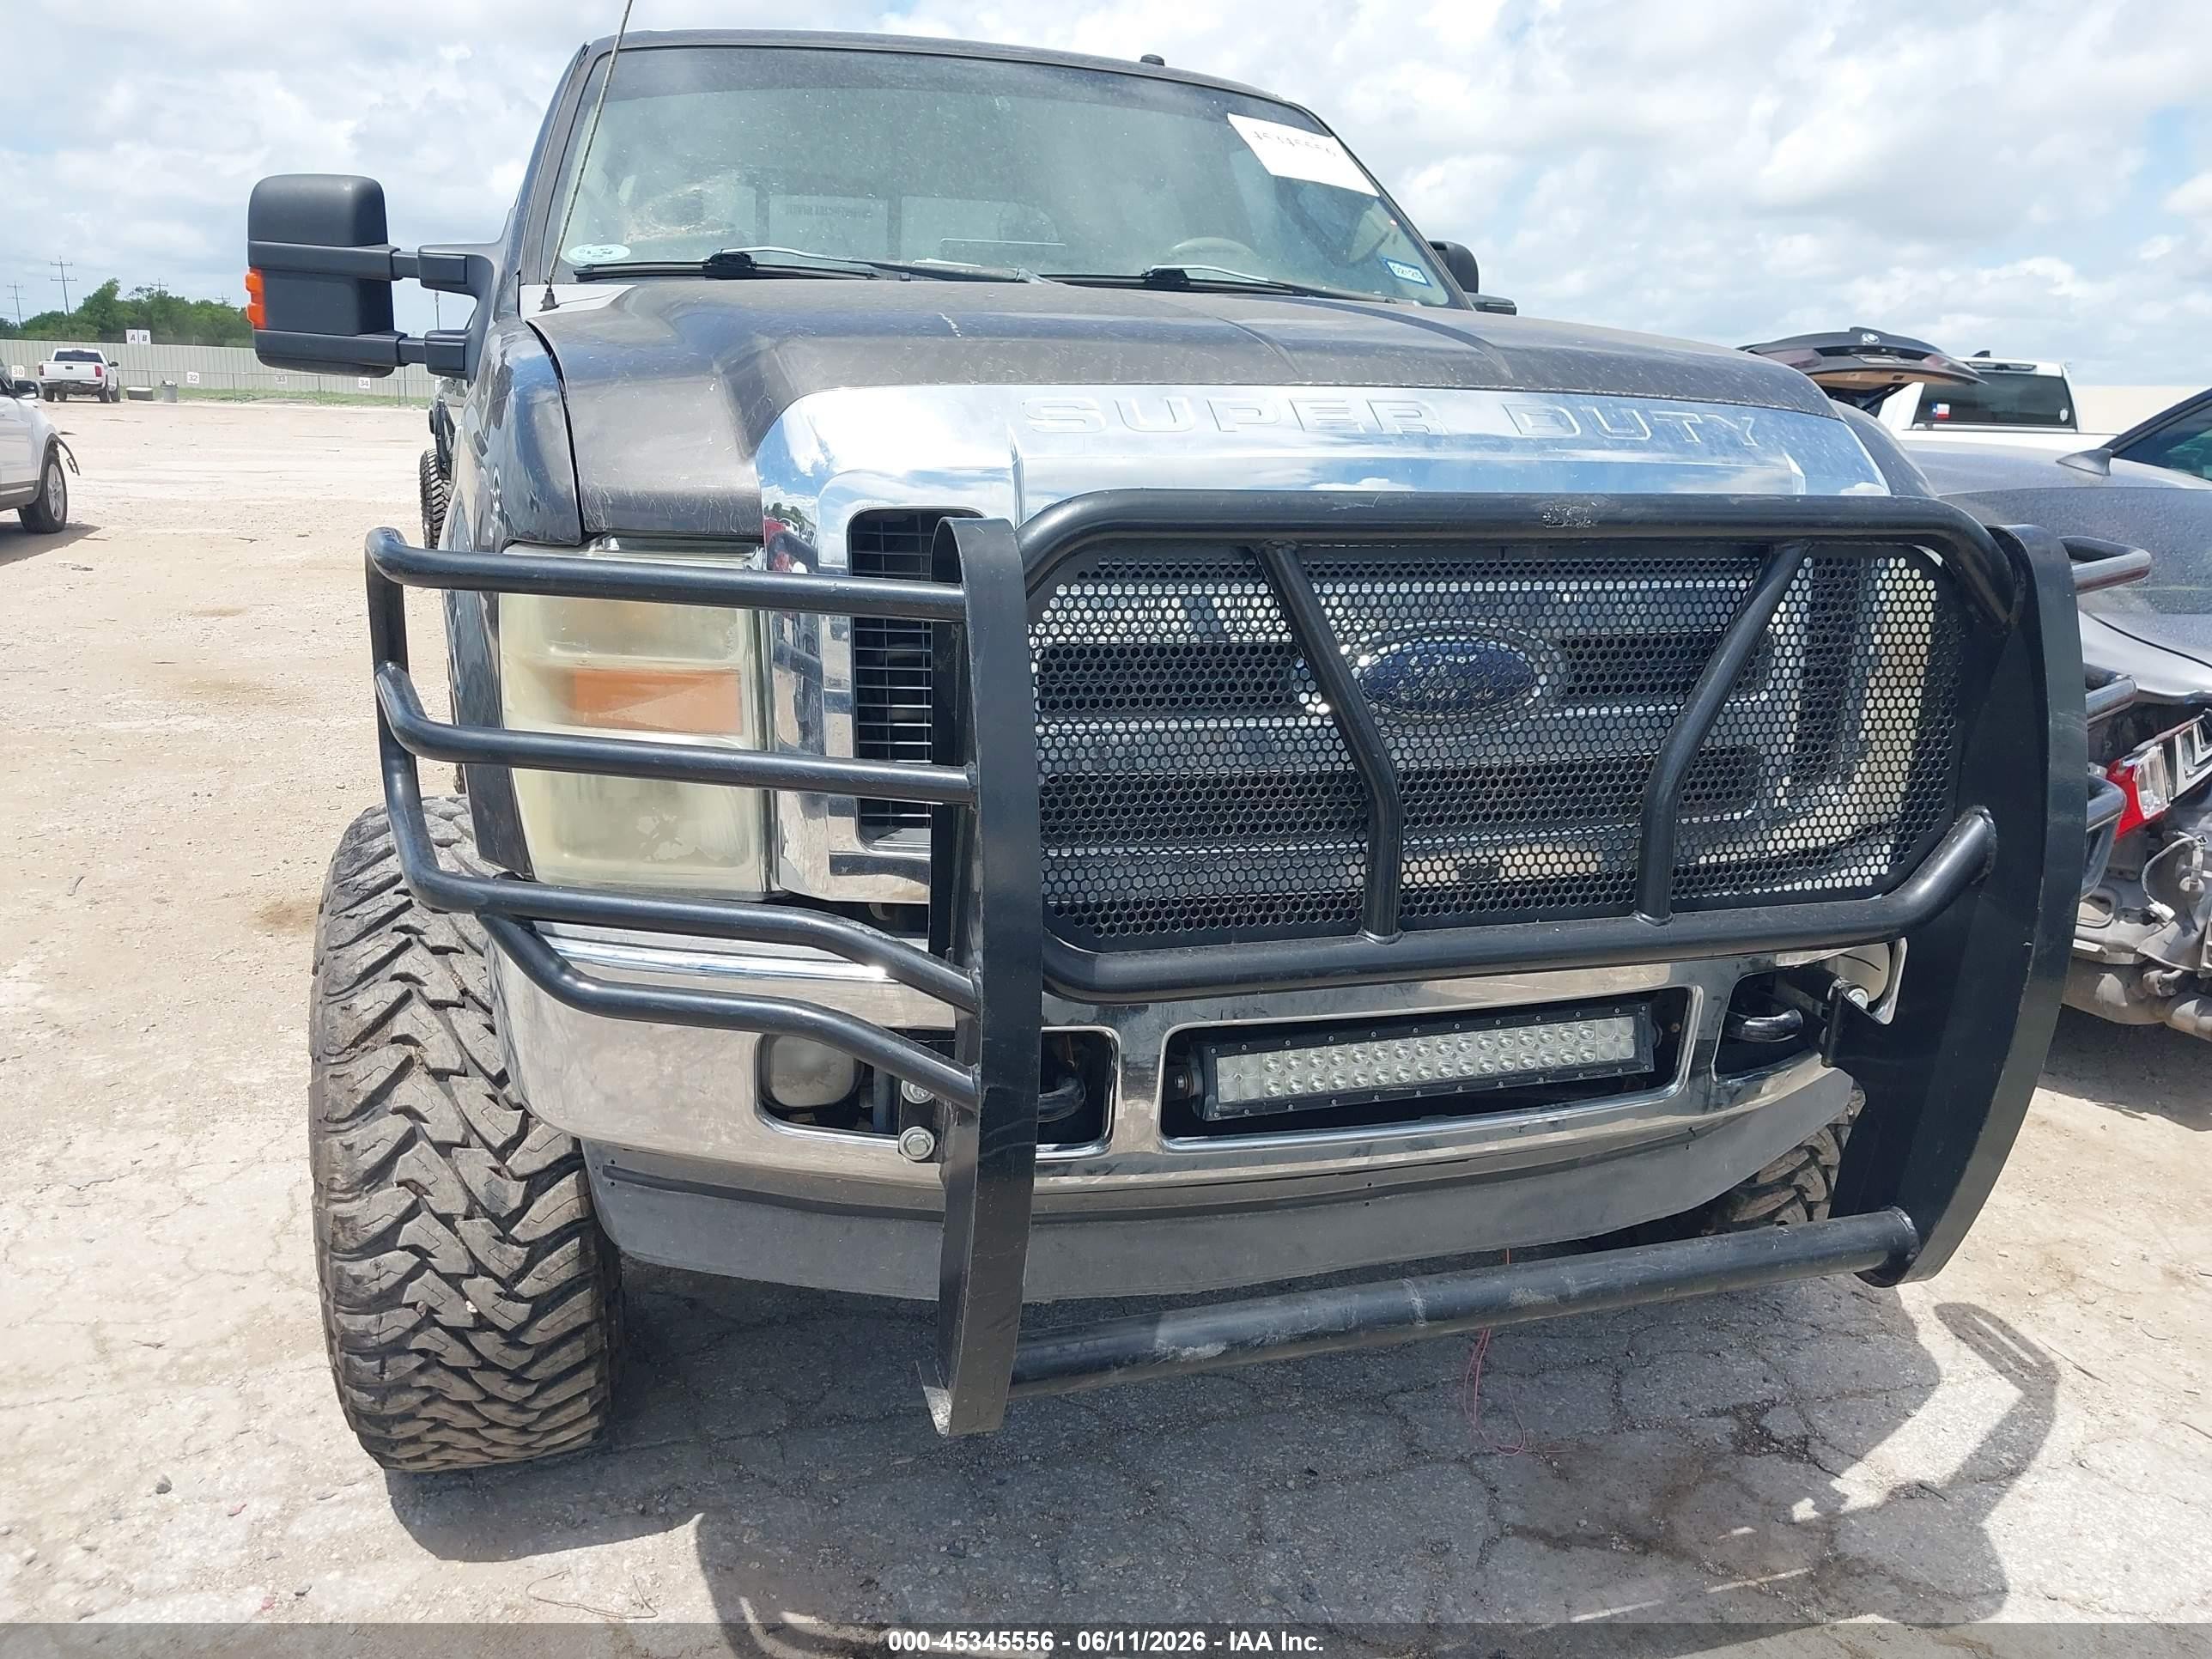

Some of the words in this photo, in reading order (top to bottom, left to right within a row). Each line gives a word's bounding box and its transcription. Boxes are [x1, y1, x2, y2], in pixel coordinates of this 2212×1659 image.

[359, 379, 369, 387] 34
[1018, 396, 1449, 436] SUPER
[1502, 403, 1761, 447] DUTY
